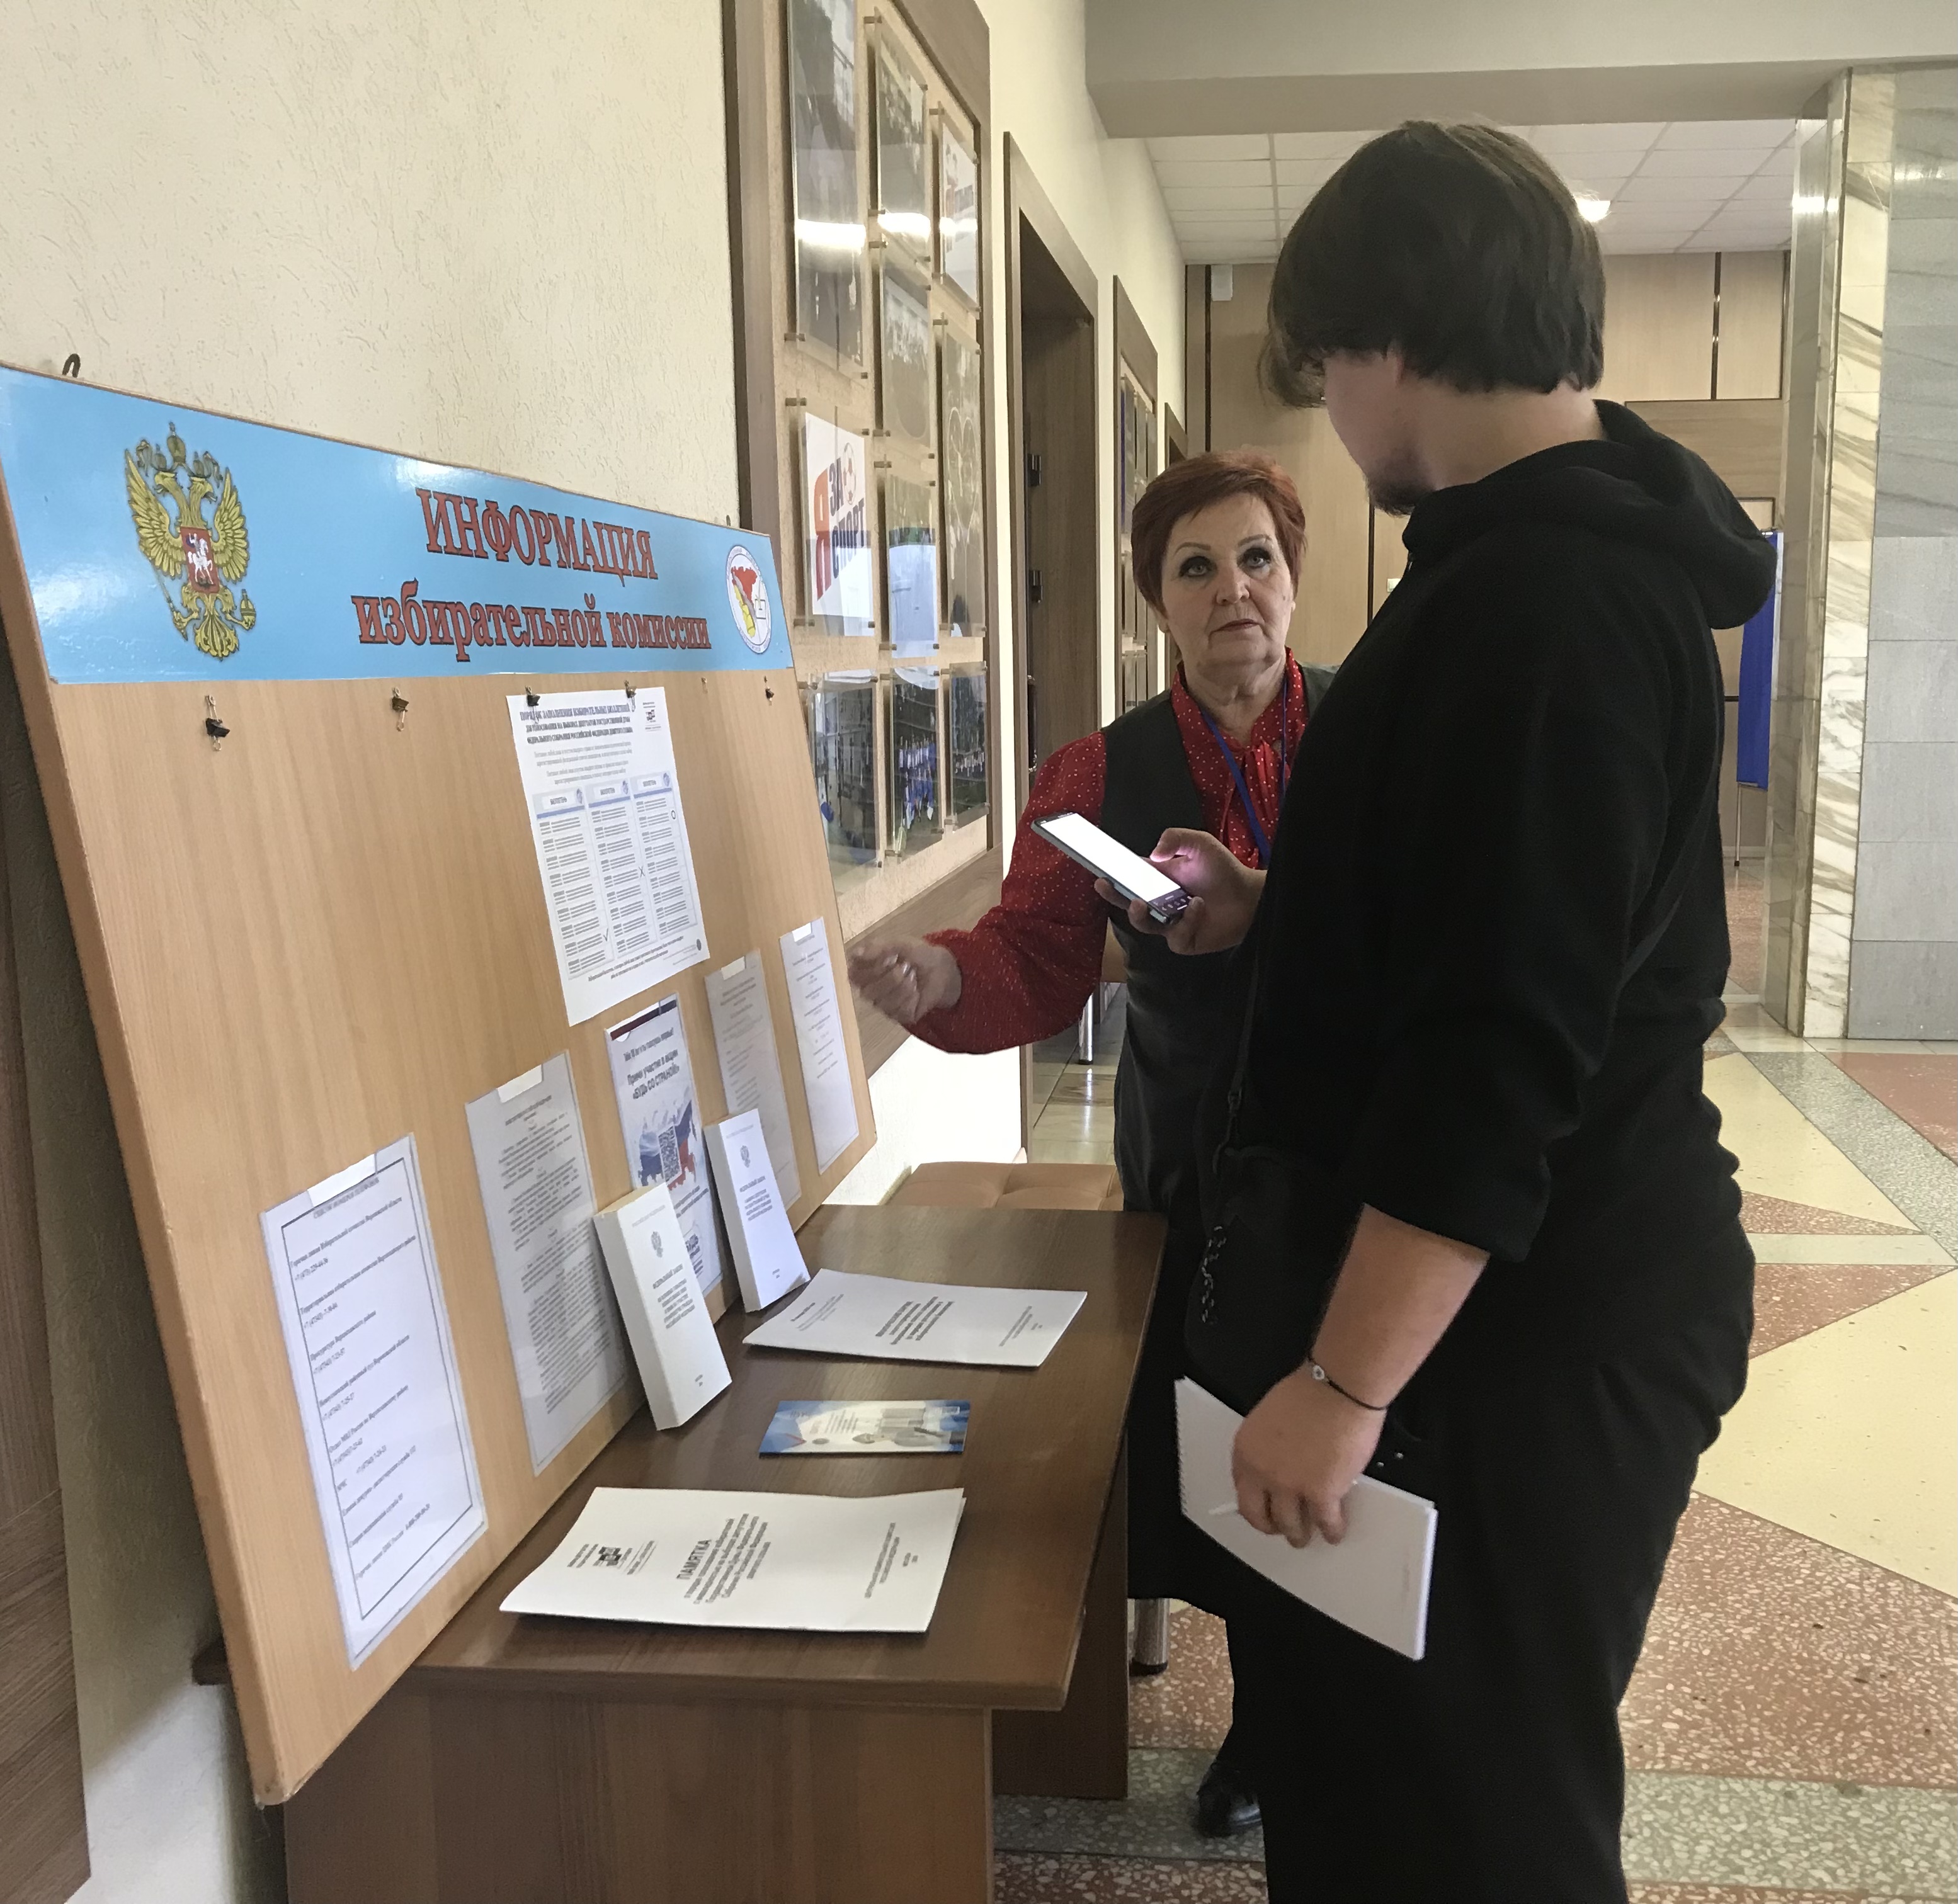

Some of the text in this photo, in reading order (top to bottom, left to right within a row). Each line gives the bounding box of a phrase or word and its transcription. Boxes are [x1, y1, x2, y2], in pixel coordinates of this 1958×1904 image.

[829, 456, 844, 516] ЗА
[415, 488, 658, 587] ИНФОРМАЦИЯ
[814, 468, 832, 601] Я
[832, 498, 864, 579] СПОРТ
[351, 577, 712, 662] избирательной комиссии
[676, 1539, 712, 1580] ПАМЯТКА
